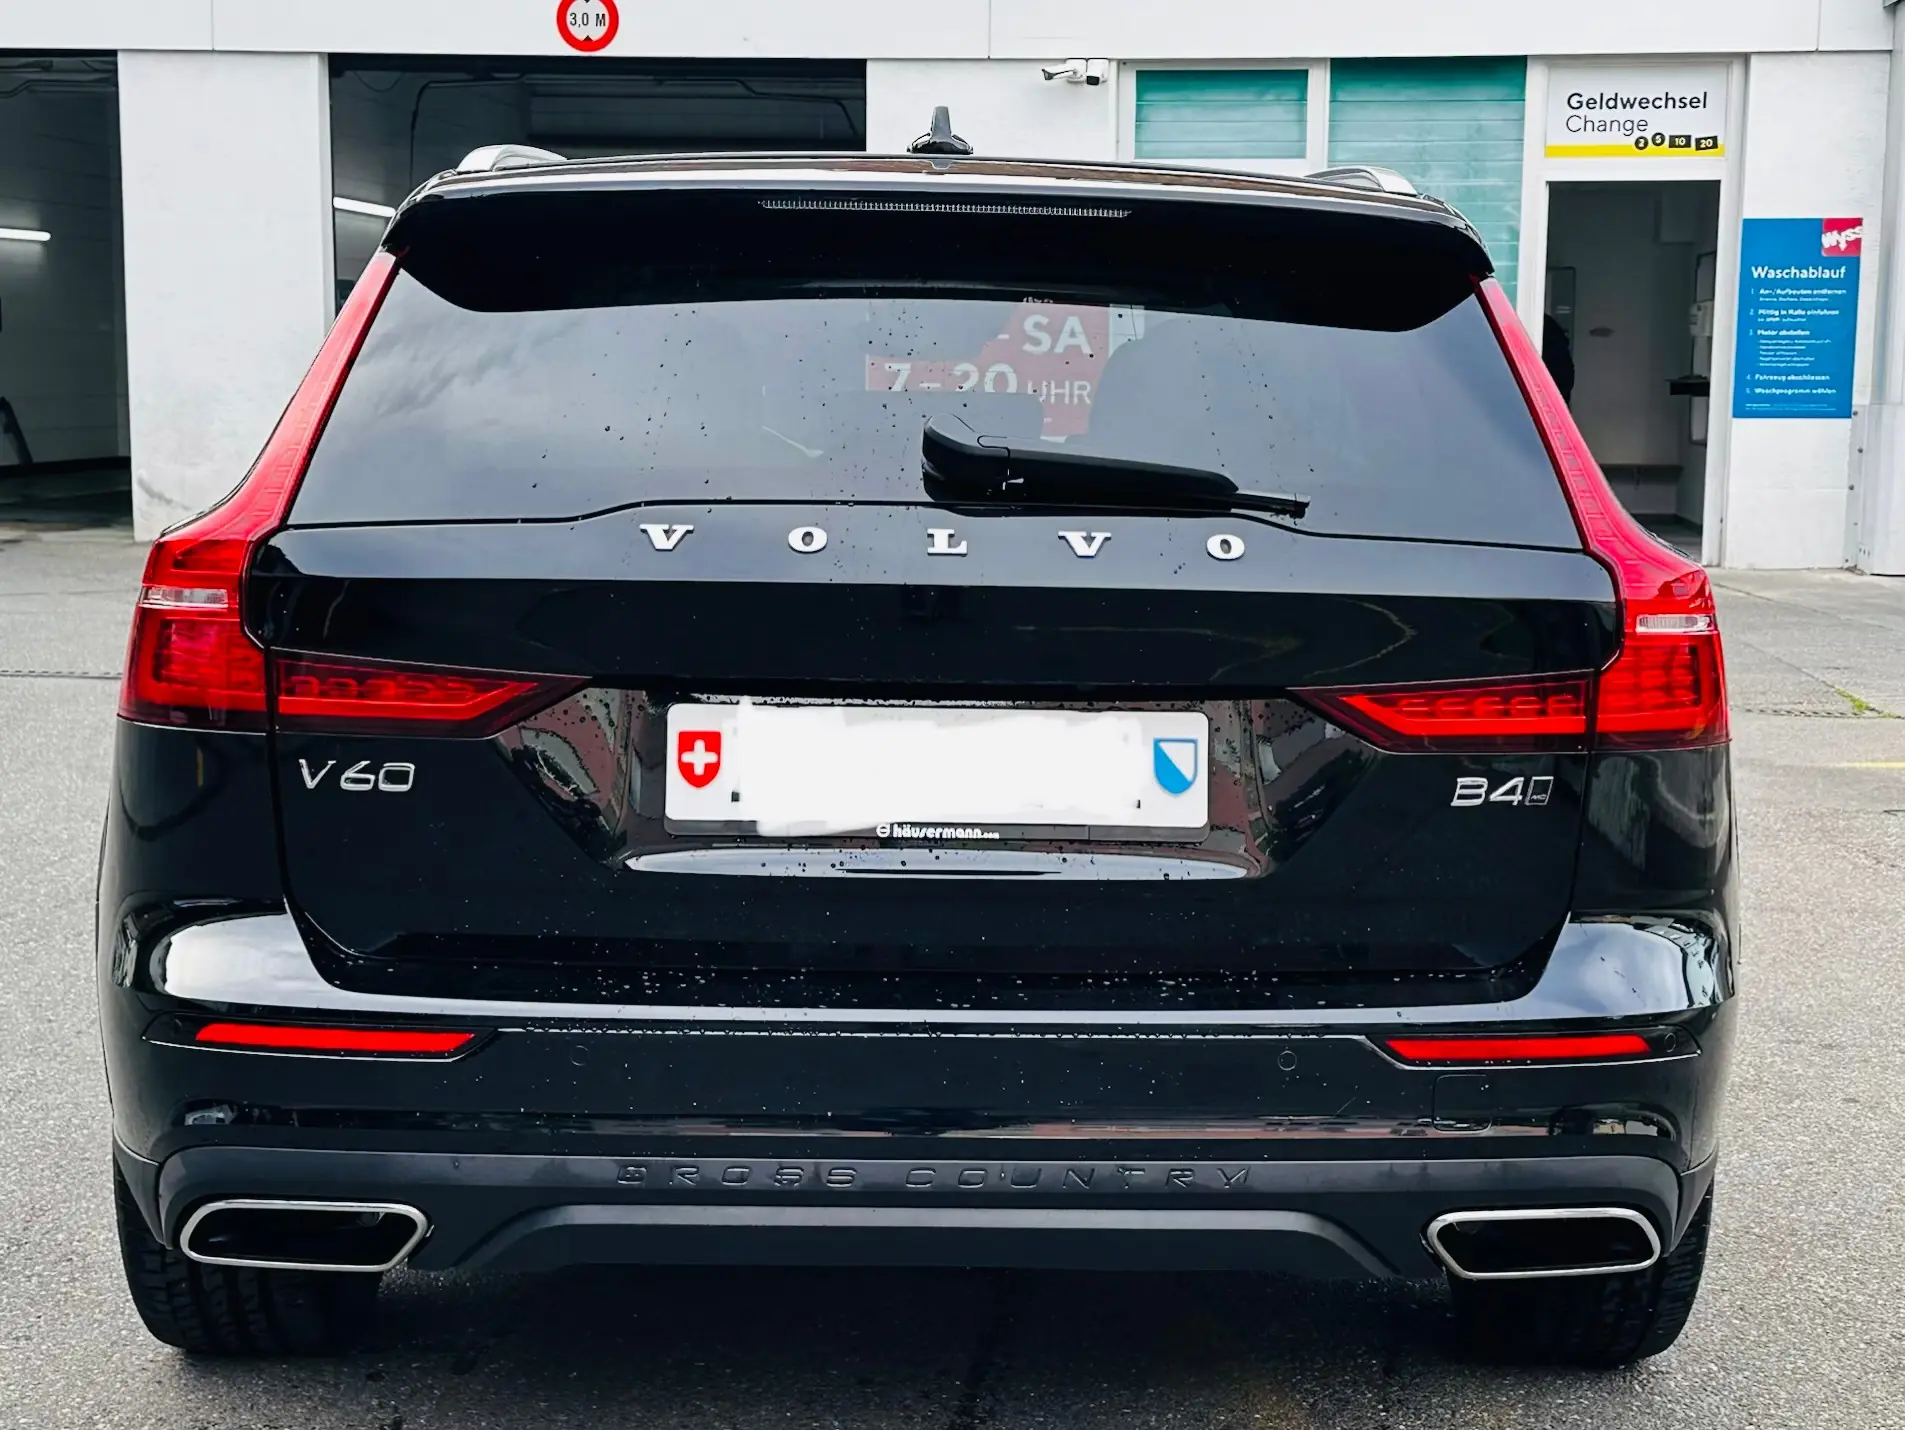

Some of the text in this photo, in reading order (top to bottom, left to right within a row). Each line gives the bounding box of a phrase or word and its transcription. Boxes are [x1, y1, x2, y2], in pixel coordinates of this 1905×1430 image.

[570, 12, 606, 28] 3,0 M
[1567, 91, 1708, 110] Geldwechsel
[1566, 114, 1649, 137] Change
[1675, 137, 1686, 146] 10
[1700, 139, 1714, 148] 20
[1751, 265, 1847, 279] Waschablauf
[1022, 314, 1093, 355] SA
[640, 523, 1245, 562] VOLVO
[298, 758, 416, 792] V60
[1450, 777, 1525, 806] B4
[616, 1163, 1251, 1189] CROSS COUNTRY
